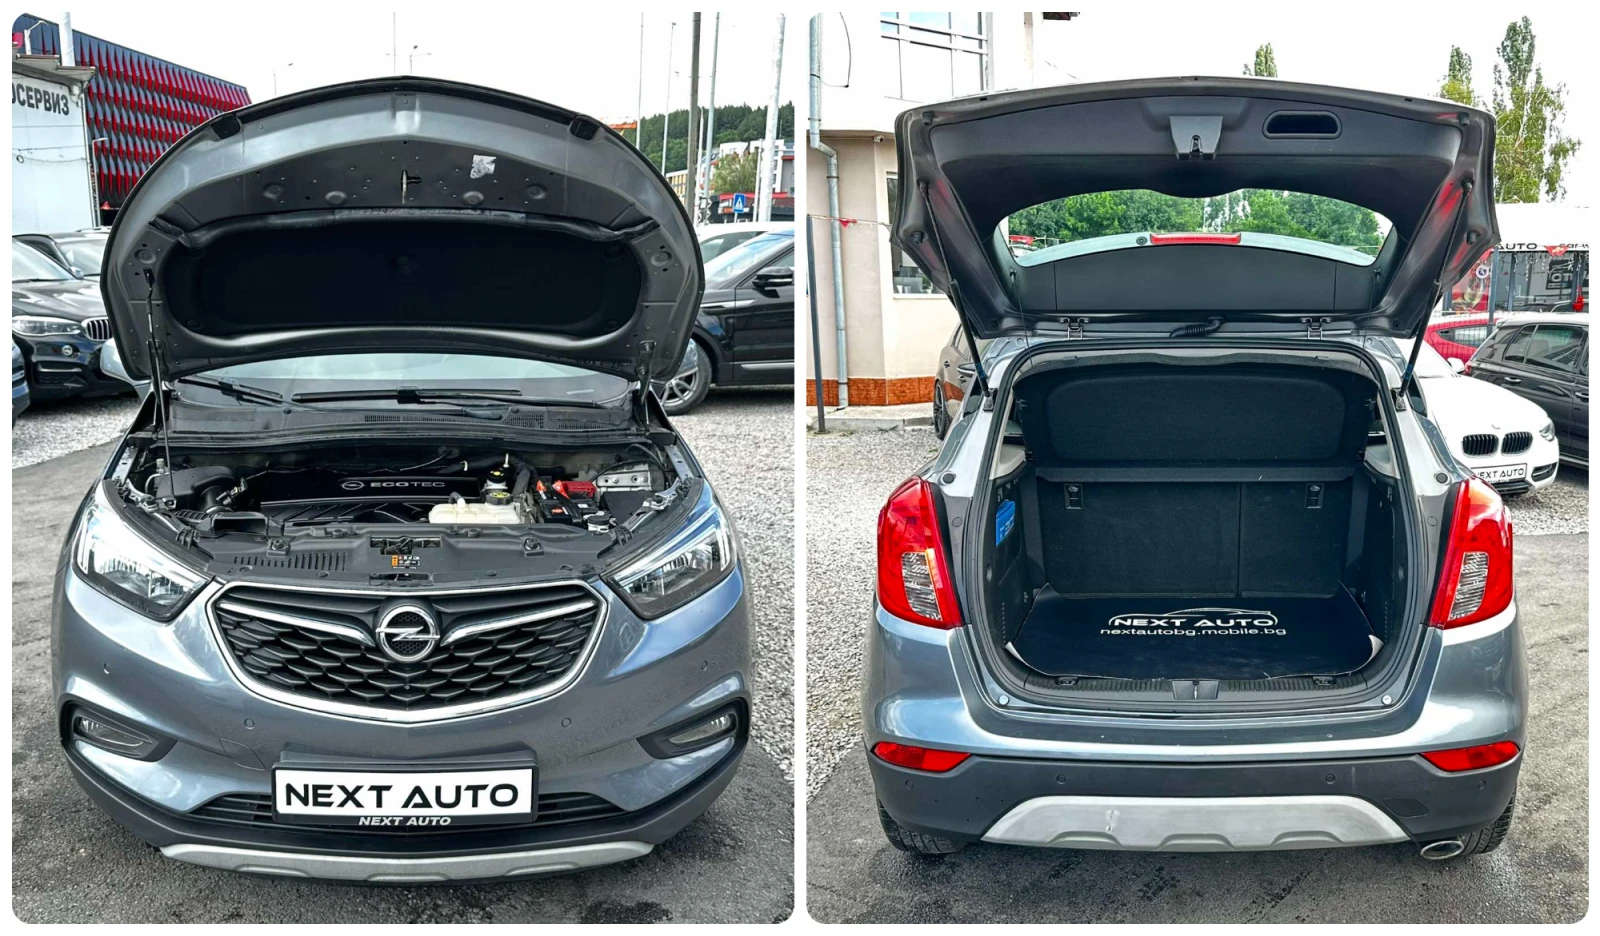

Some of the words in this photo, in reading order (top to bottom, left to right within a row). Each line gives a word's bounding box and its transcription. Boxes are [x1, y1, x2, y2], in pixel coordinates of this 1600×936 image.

[1478, 471, 1498, 479] EXT
[1499, 468, 1524, 478] AUTO
[1113, 618, 1187, 627] NEXT
[1193, 618, 1274, 627] AUTO
[1100, 627, 1287, 637] nextautobg.mobile.bg
[285, 783, 393, 809] NEXT
[400, 783, 519, 809] AUTO
[358, 816, 403, 826] NEXT
[407, 816, 452, 826] AUTO
